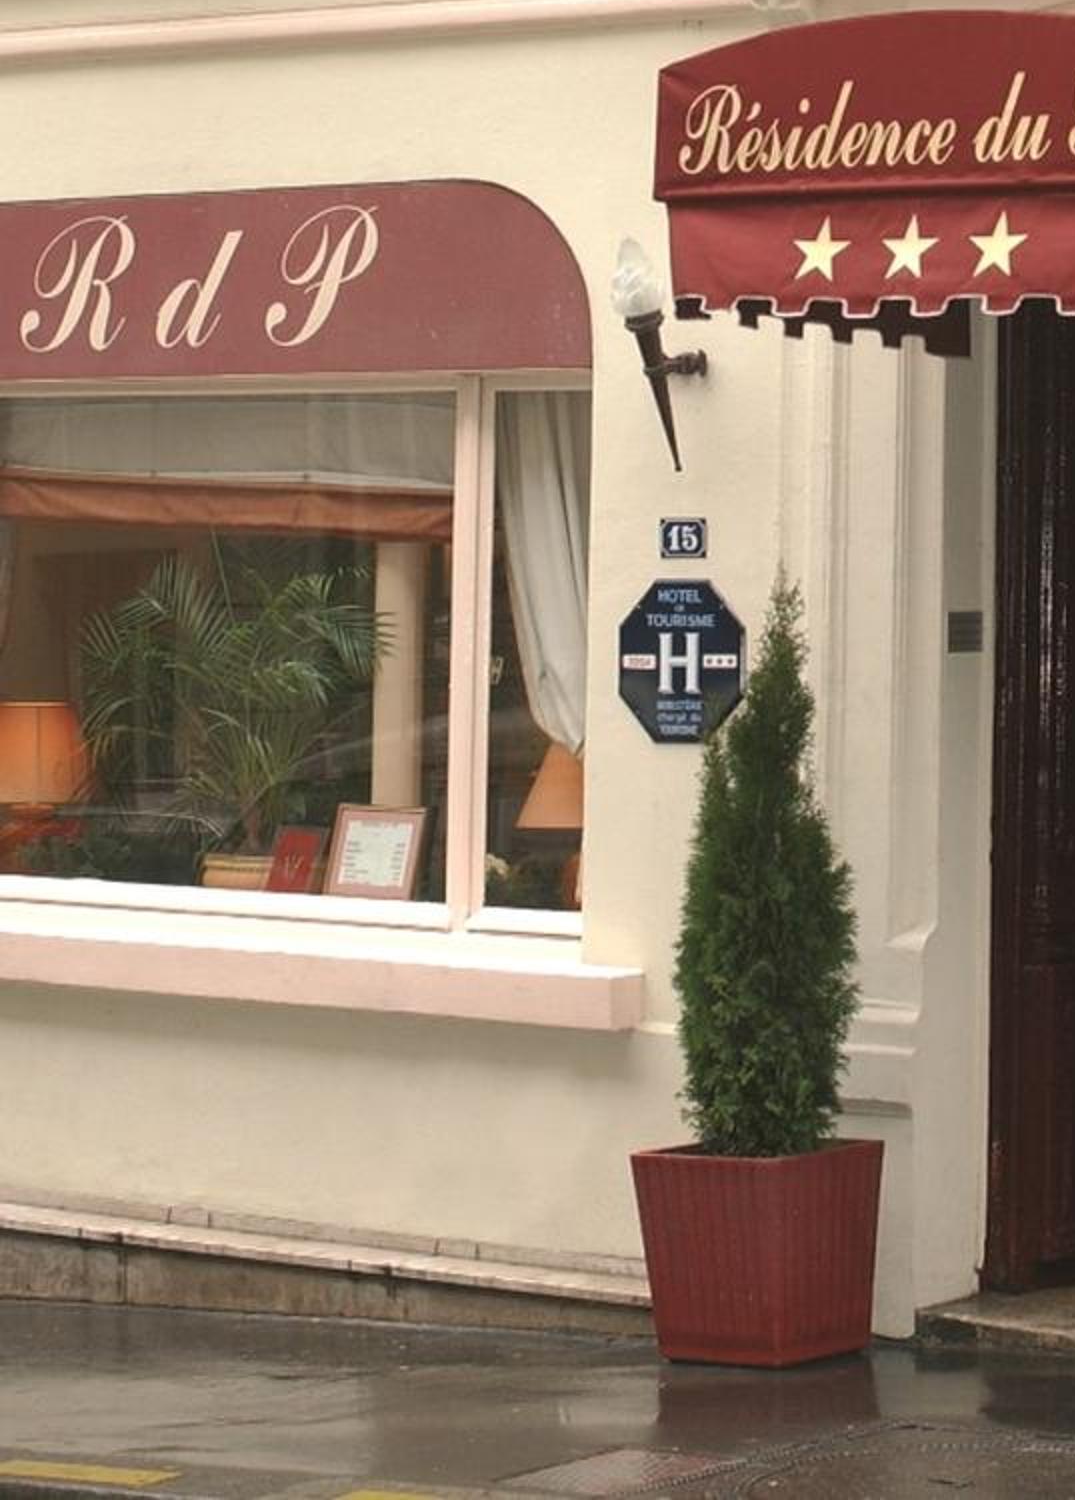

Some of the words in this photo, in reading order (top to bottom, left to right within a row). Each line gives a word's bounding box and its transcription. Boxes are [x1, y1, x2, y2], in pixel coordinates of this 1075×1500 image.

[678, 79, 955, 176] Résidence
[972, 70, 1053, 164] du
[19, 214, 136, 353] R
[154, 229, 244, 350] d
[264, 204, 379, 348] P
[666, 524, 699, 551] 15
[657, 589, 703, 604] HOTEL
[645, 613, 716, 628] TOURISME
[657, 631, 702, 695] H
